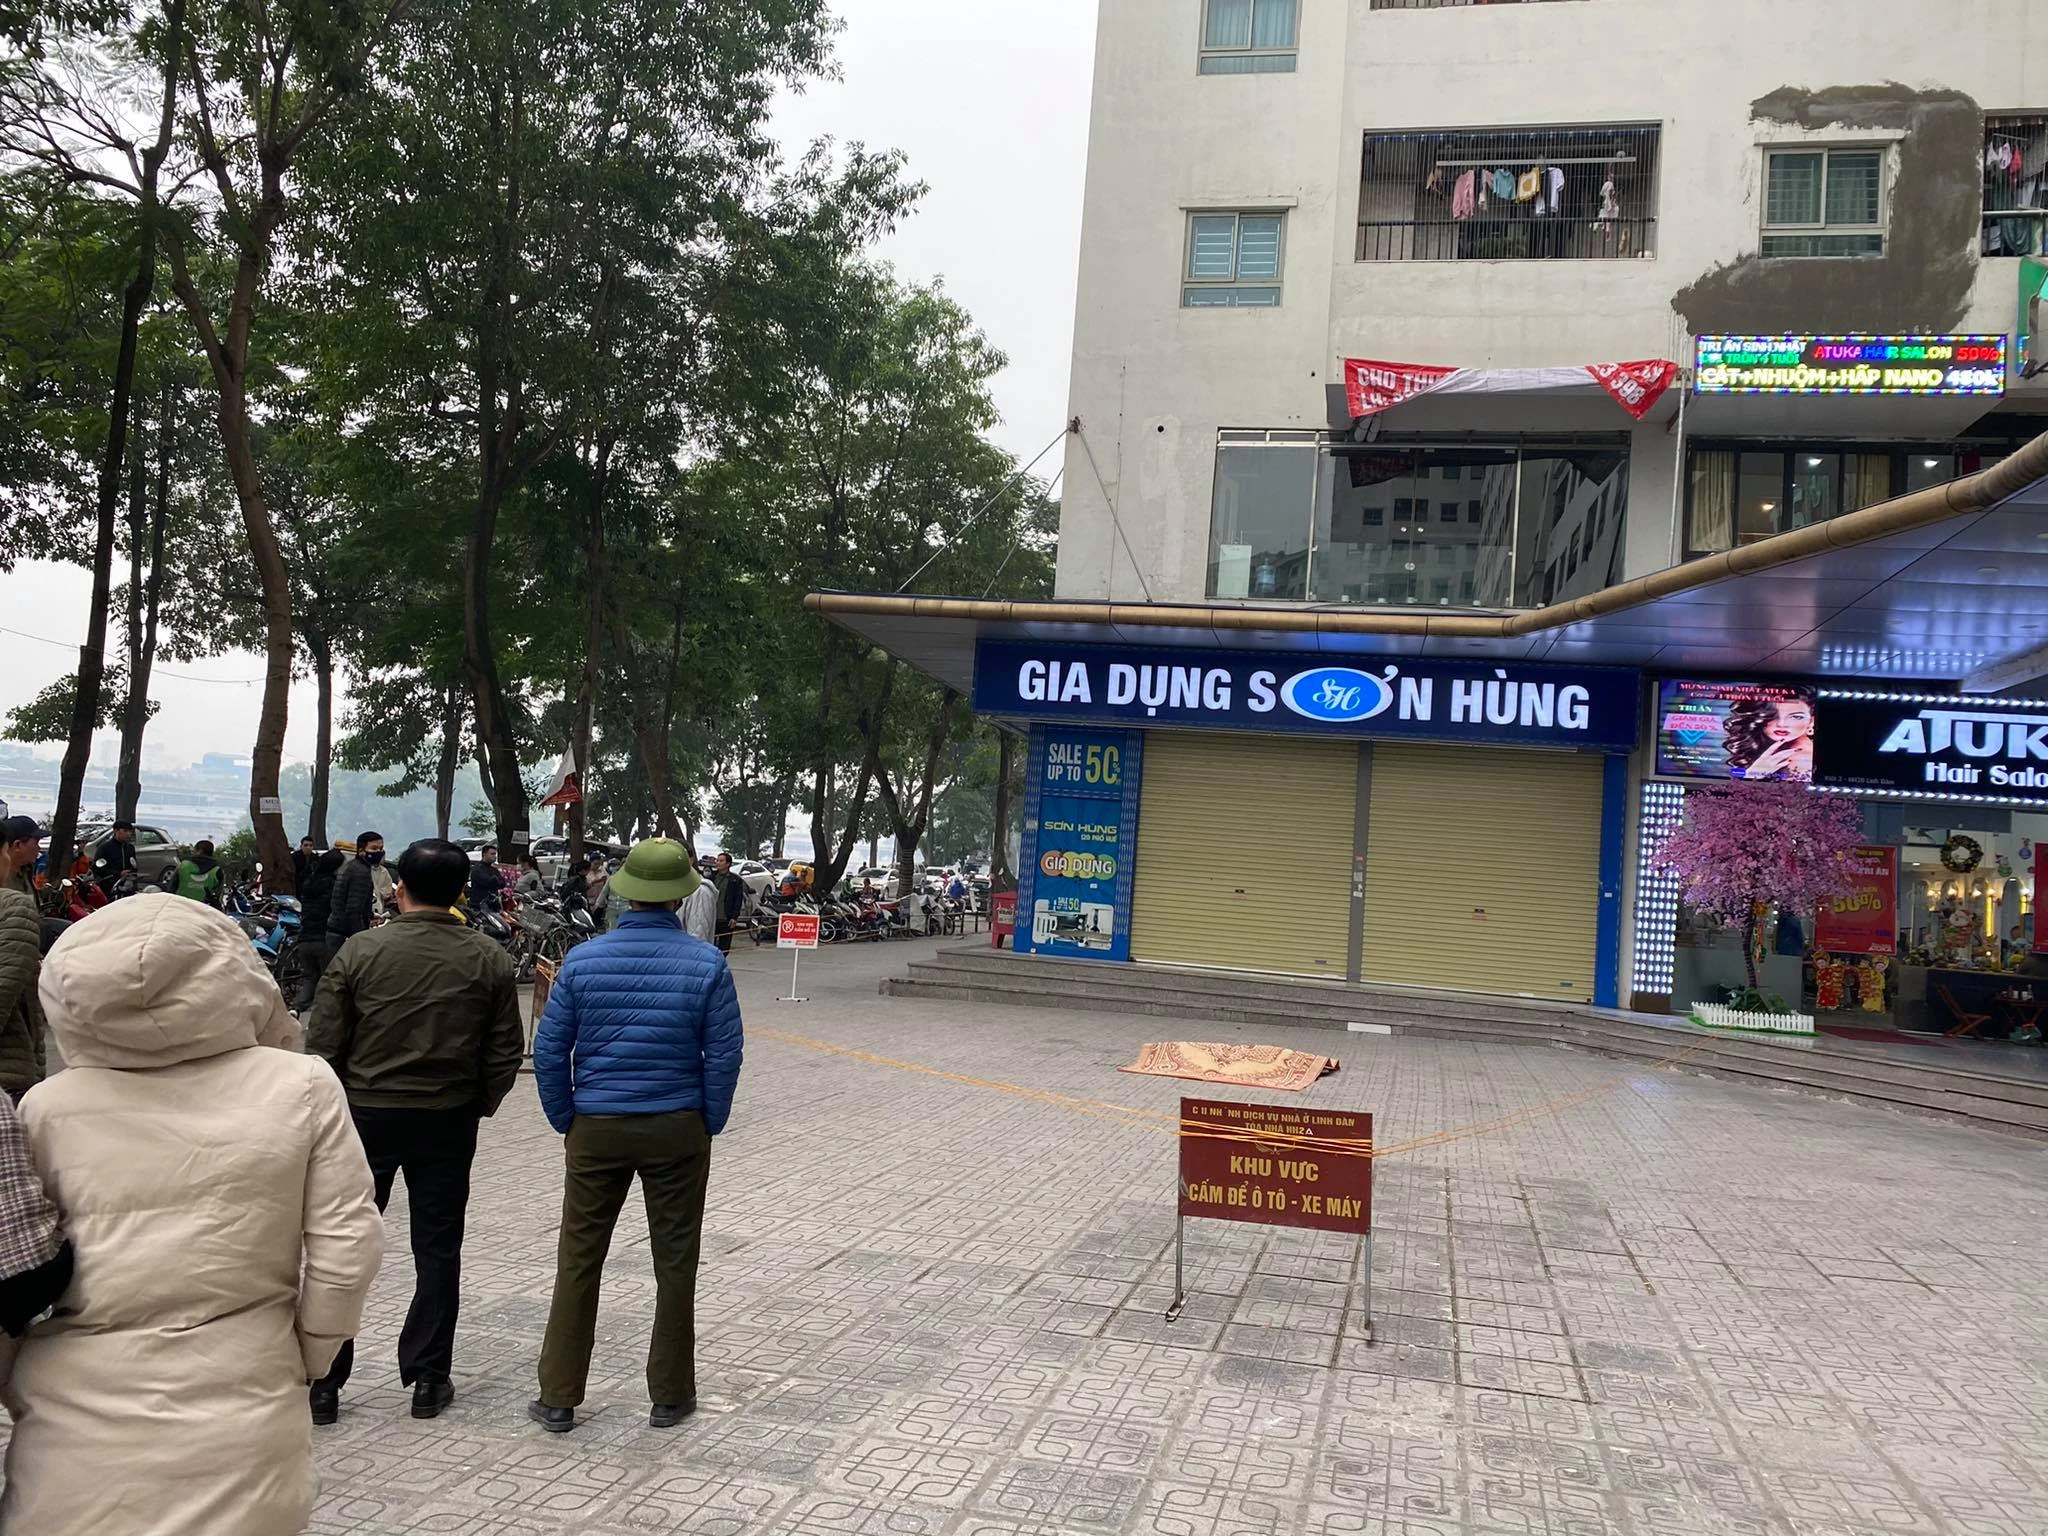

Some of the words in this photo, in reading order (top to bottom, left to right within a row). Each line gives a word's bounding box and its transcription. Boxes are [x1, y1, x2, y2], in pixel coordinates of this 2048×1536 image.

[1864, 346, 1899, 359] HAIR
[1901, 346, 1953, 359] SALON
[1357, 367, 1397, 390] CHO
[1884, 368, 1944, 386] NANO
[1018, 660, 1092, 703] GIA
[1107, 663, 1232, 716] DỤNG
[1450, 669, 1589, 729] HÙNG
[1048, 743, 1082, 764] SALE
[1047, 765, 1063, 780] UP
[1066, 765, 1081, 782] TO
[1925, 762, 1983, 784] Hair
[1045, 856, 1068, 871] GIA
[1281, 1112, 1301, 1123] NHÀ
[1312, 1116, 1334, 1126] LINH
[1230, 1155, 1272, 1177] KHU
[1278, 1160, 1319, 1184] VỰC
[1189, 1179, 1223, 1204] CẤM
[1252, 1185, 1263, 1208] Ô
[1266, 1188, 1286, 1211] TÔ
[1301, 1194, 1321, 1215] XE
[1326, 1195, 1362, 1218] MÁY
